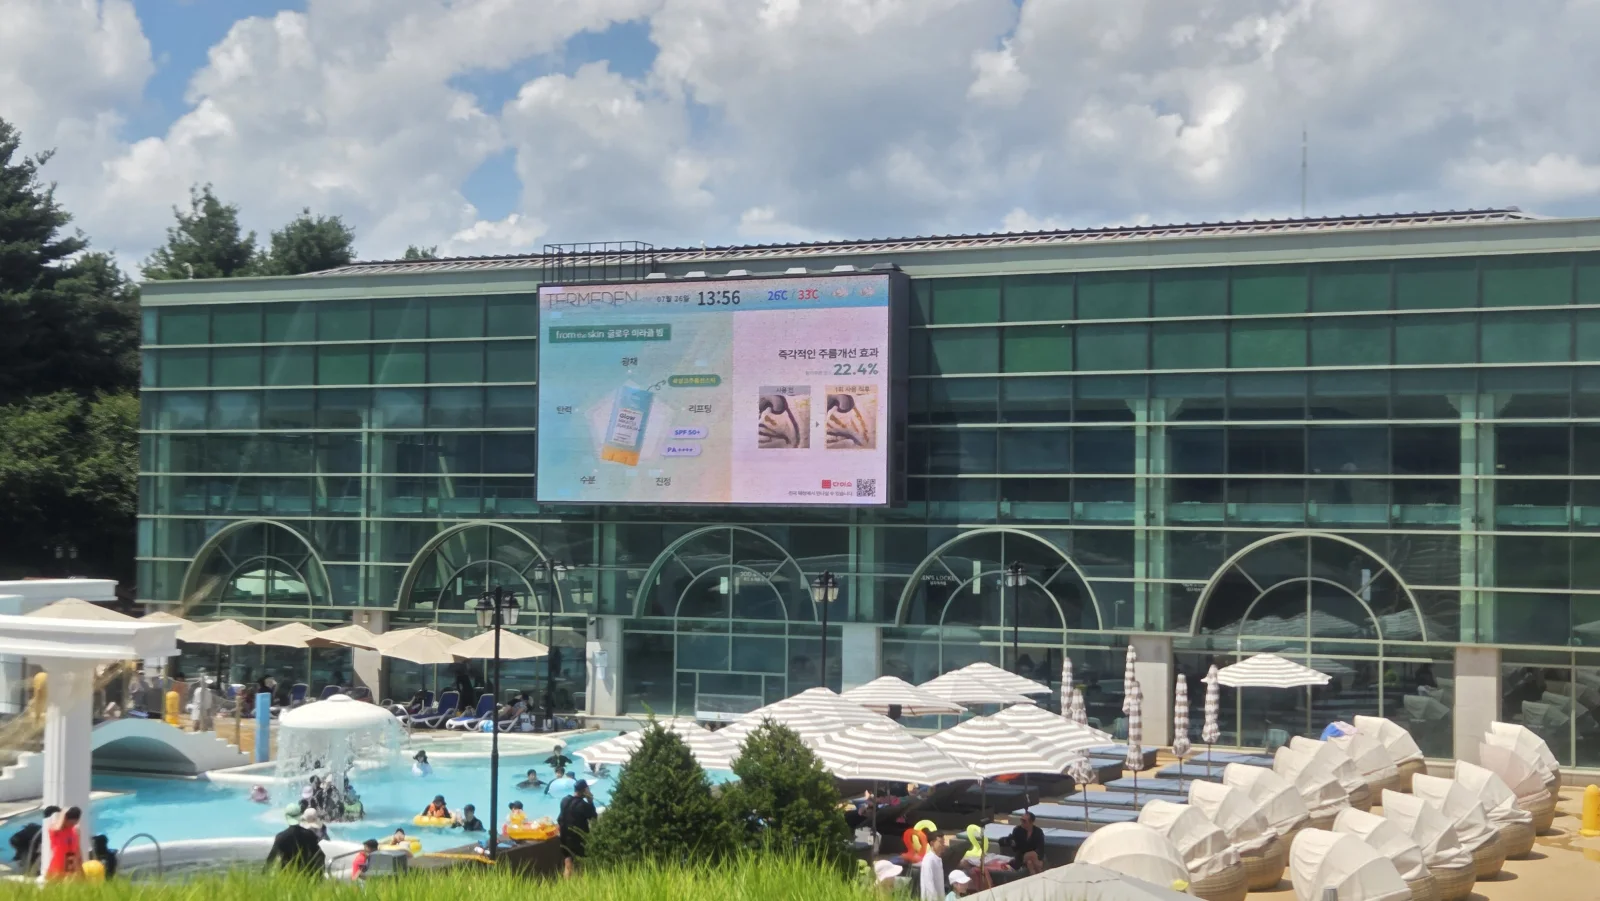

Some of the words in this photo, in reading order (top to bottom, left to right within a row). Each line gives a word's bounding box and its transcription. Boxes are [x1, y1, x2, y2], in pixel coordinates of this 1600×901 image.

[698, 290, 740, 306] 13:56
[778, 348, 816, 360] 즉각적인
[818, 348, 857, 358] 주름개선
[860, 348, 879, 358] 효과
[834, 363, 878, 376] 22.4%
[556, 406, 572, 414] 탄력
[689, 404, 712, 413] 리프팅
[580, 476, 596, 484] 수분
[656, 477, 672, 486] 진정
